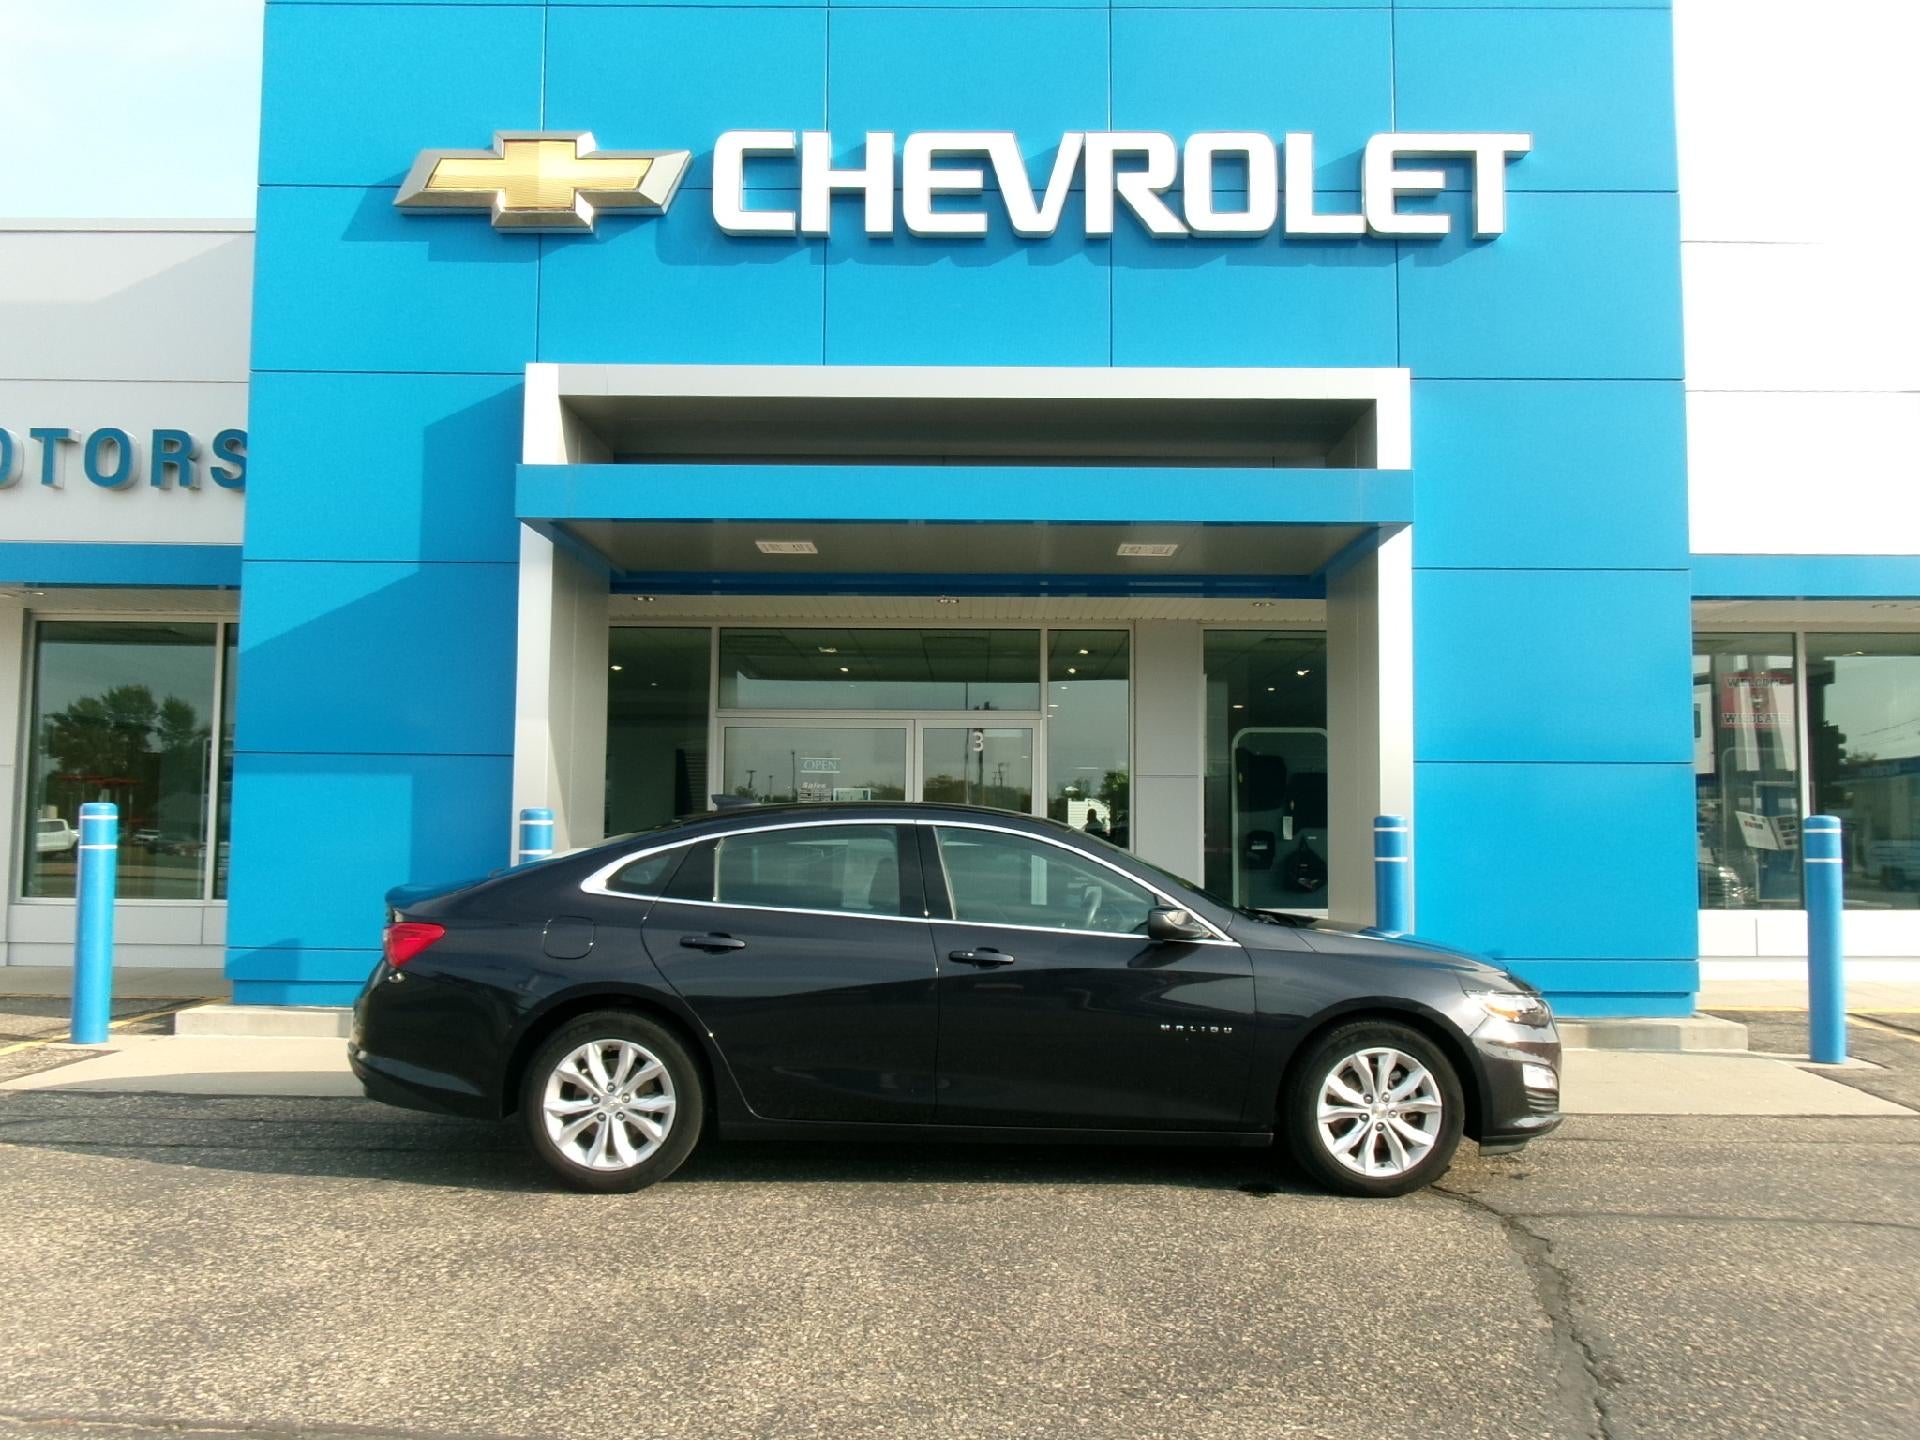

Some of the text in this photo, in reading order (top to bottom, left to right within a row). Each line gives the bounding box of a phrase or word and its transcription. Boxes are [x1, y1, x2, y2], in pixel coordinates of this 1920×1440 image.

[712, 130, 1533, 239] CHEVROLET
[0, 427, 248, 490] TORS
[973, 732, 984, 752] 3
[803, 760, 836, 770] OPEN
[1160, 1024, 1233, 1034] MALIBU
